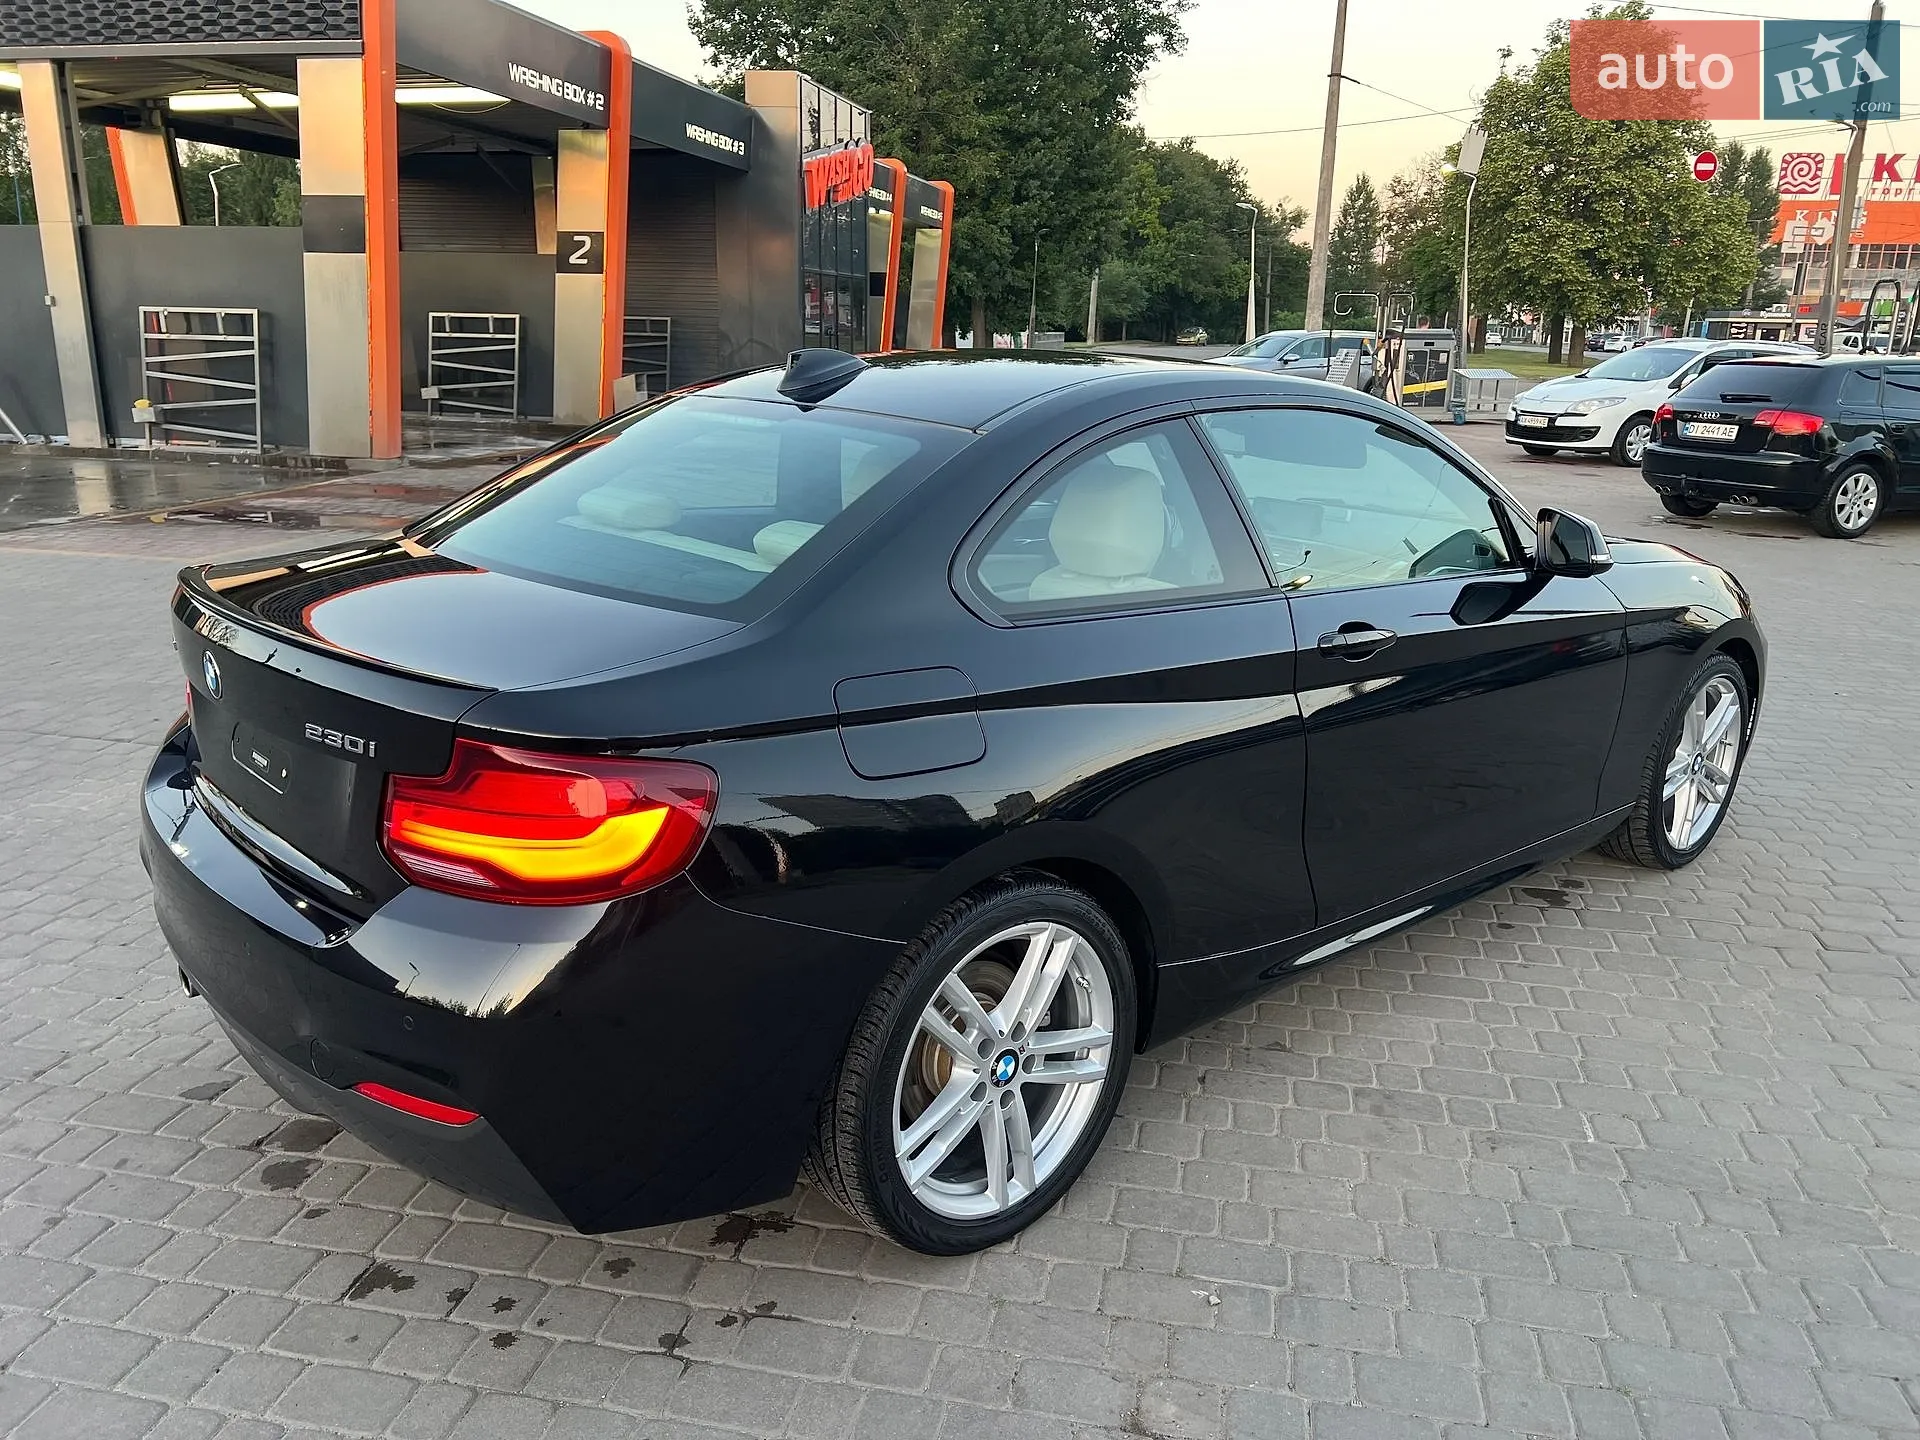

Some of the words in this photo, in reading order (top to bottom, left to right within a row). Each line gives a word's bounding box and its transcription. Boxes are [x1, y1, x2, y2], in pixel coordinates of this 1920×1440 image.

[508, 62, 562, 97] WASHING
[563, 81, 585, 104] BOX
[685, 122, 719, 147] WASHING
[718, 134, 733, 151] BOX
[804, 150, 850, 209] WASH
[568, 235, 592, 264] 2
[1700, 425, 1721, 435] 2441
[1721, 427, 1736, 437] AE
[304, 723, 377, 758] 230i
